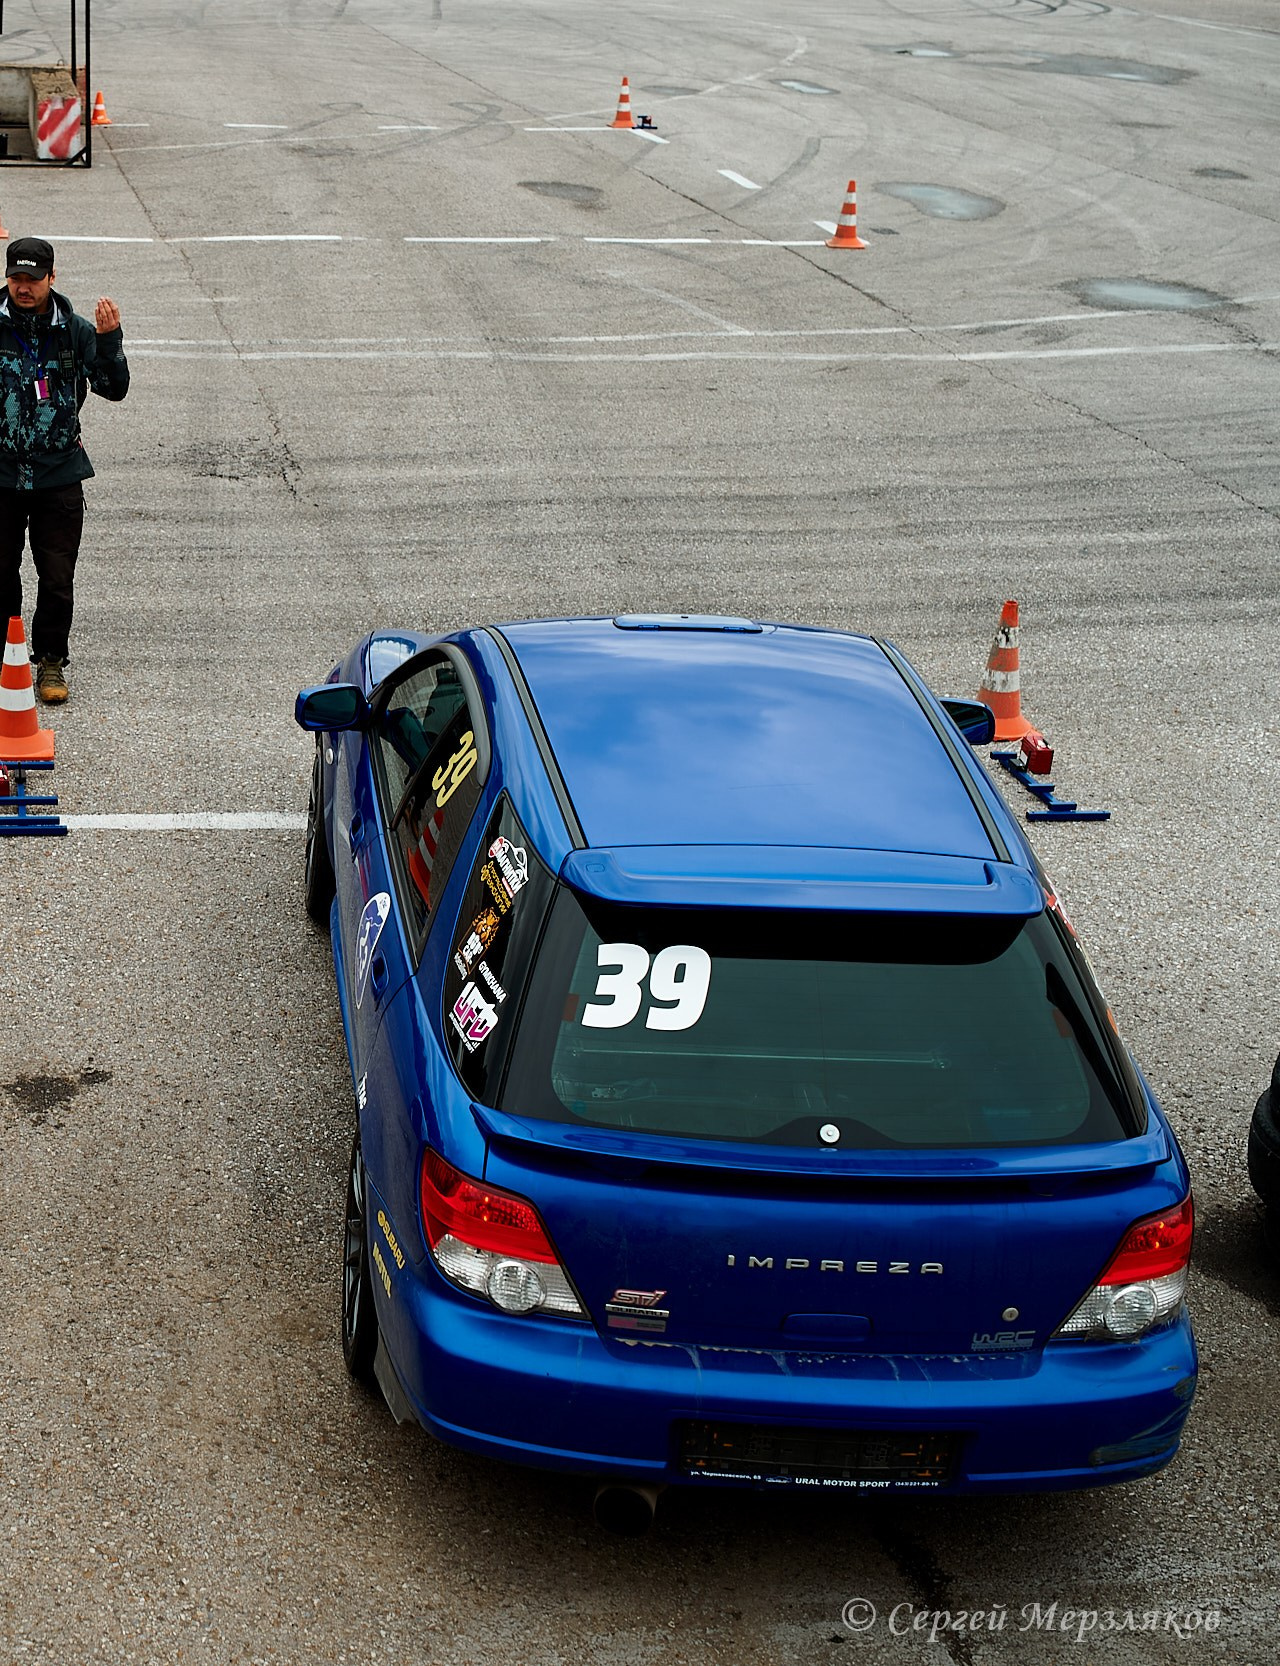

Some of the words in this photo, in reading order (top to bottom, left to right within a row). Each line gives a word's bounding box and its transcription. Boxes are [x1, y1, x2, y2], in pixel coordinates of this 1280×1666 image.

[431, 731, 477, 807] 39
[478, 960, 508, 1004] GYMKHANA
[581, 943, 712, 1031] 39
[382, 1220, 406, 1270] SUBARU
[727, 1254, 944, 1275] IMPREZA
[972, 1330, 1036, 1344] WRC
[795, 1477, 820, 1485] URAL
[822, 1479, 857, 1488] MOTOR
[859, 1480, 891, 1488] SPORT
